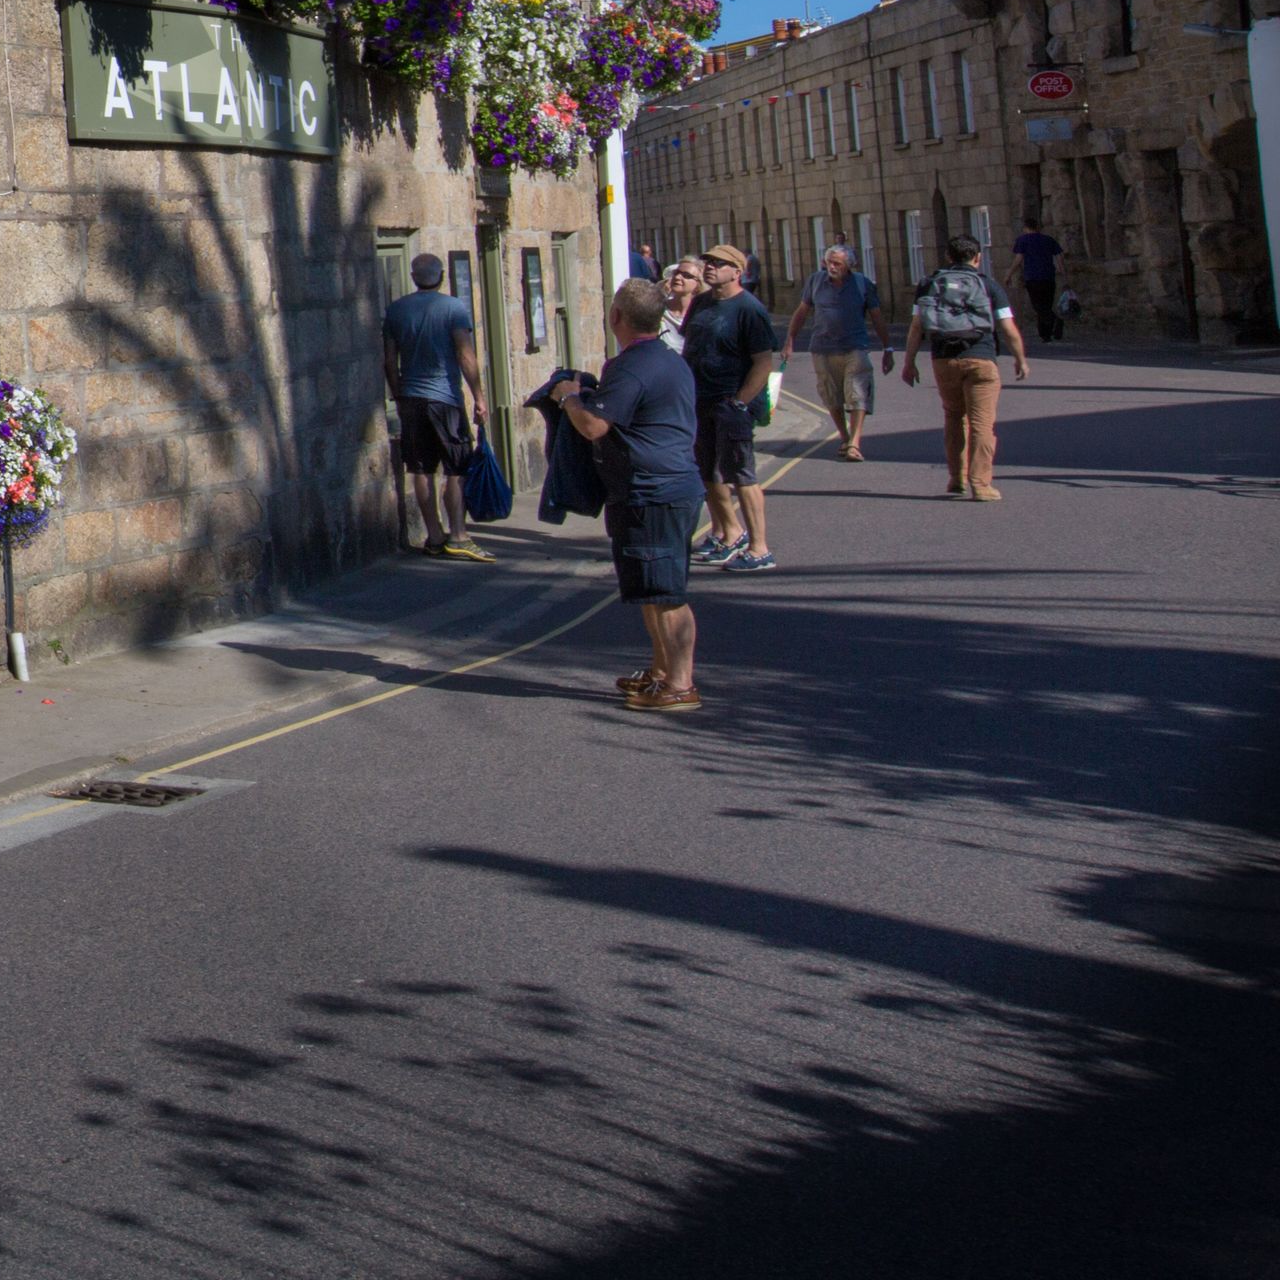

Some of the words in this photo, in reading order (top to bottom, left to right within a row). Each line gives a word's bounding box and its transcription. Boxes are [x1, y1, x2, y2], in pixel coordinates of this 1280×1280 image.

[210, 23, 244, 53] TH
[1034, 84, 1069, 93] OFFICE
[1040, 77, 1063, 85] POST
[104, 56, 318, 136] ATLANTIC
